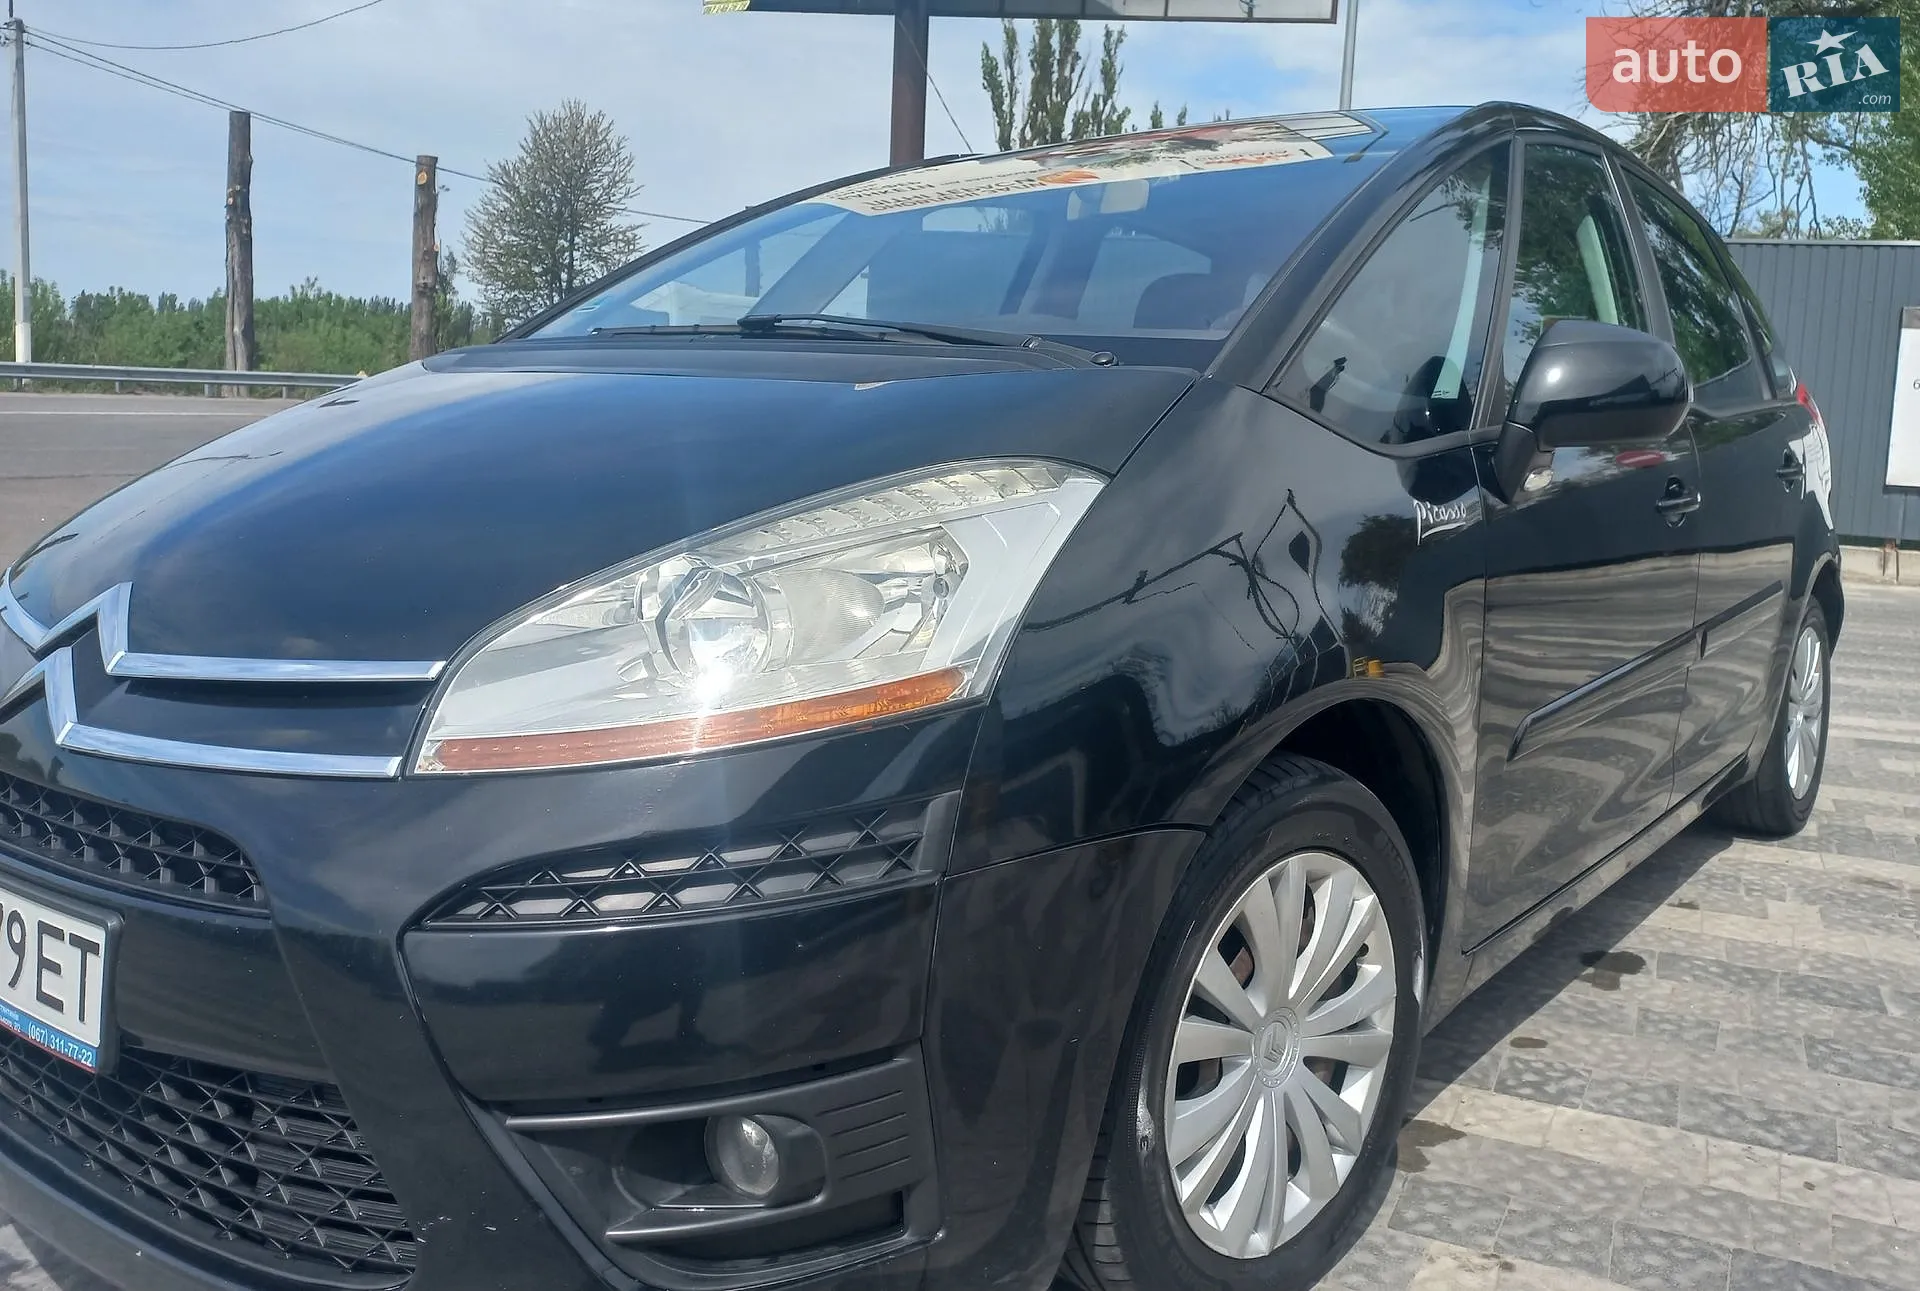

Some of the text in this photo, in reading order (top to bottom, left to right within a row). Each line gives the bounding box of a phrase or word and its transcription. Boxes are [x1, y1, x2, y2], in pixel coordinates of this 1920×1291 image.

[1413, 499, 1467, 546] Picasso
[28, 1021, 48, 1048] (067)
[50, 1034, 93, 1067] 311-77-22
